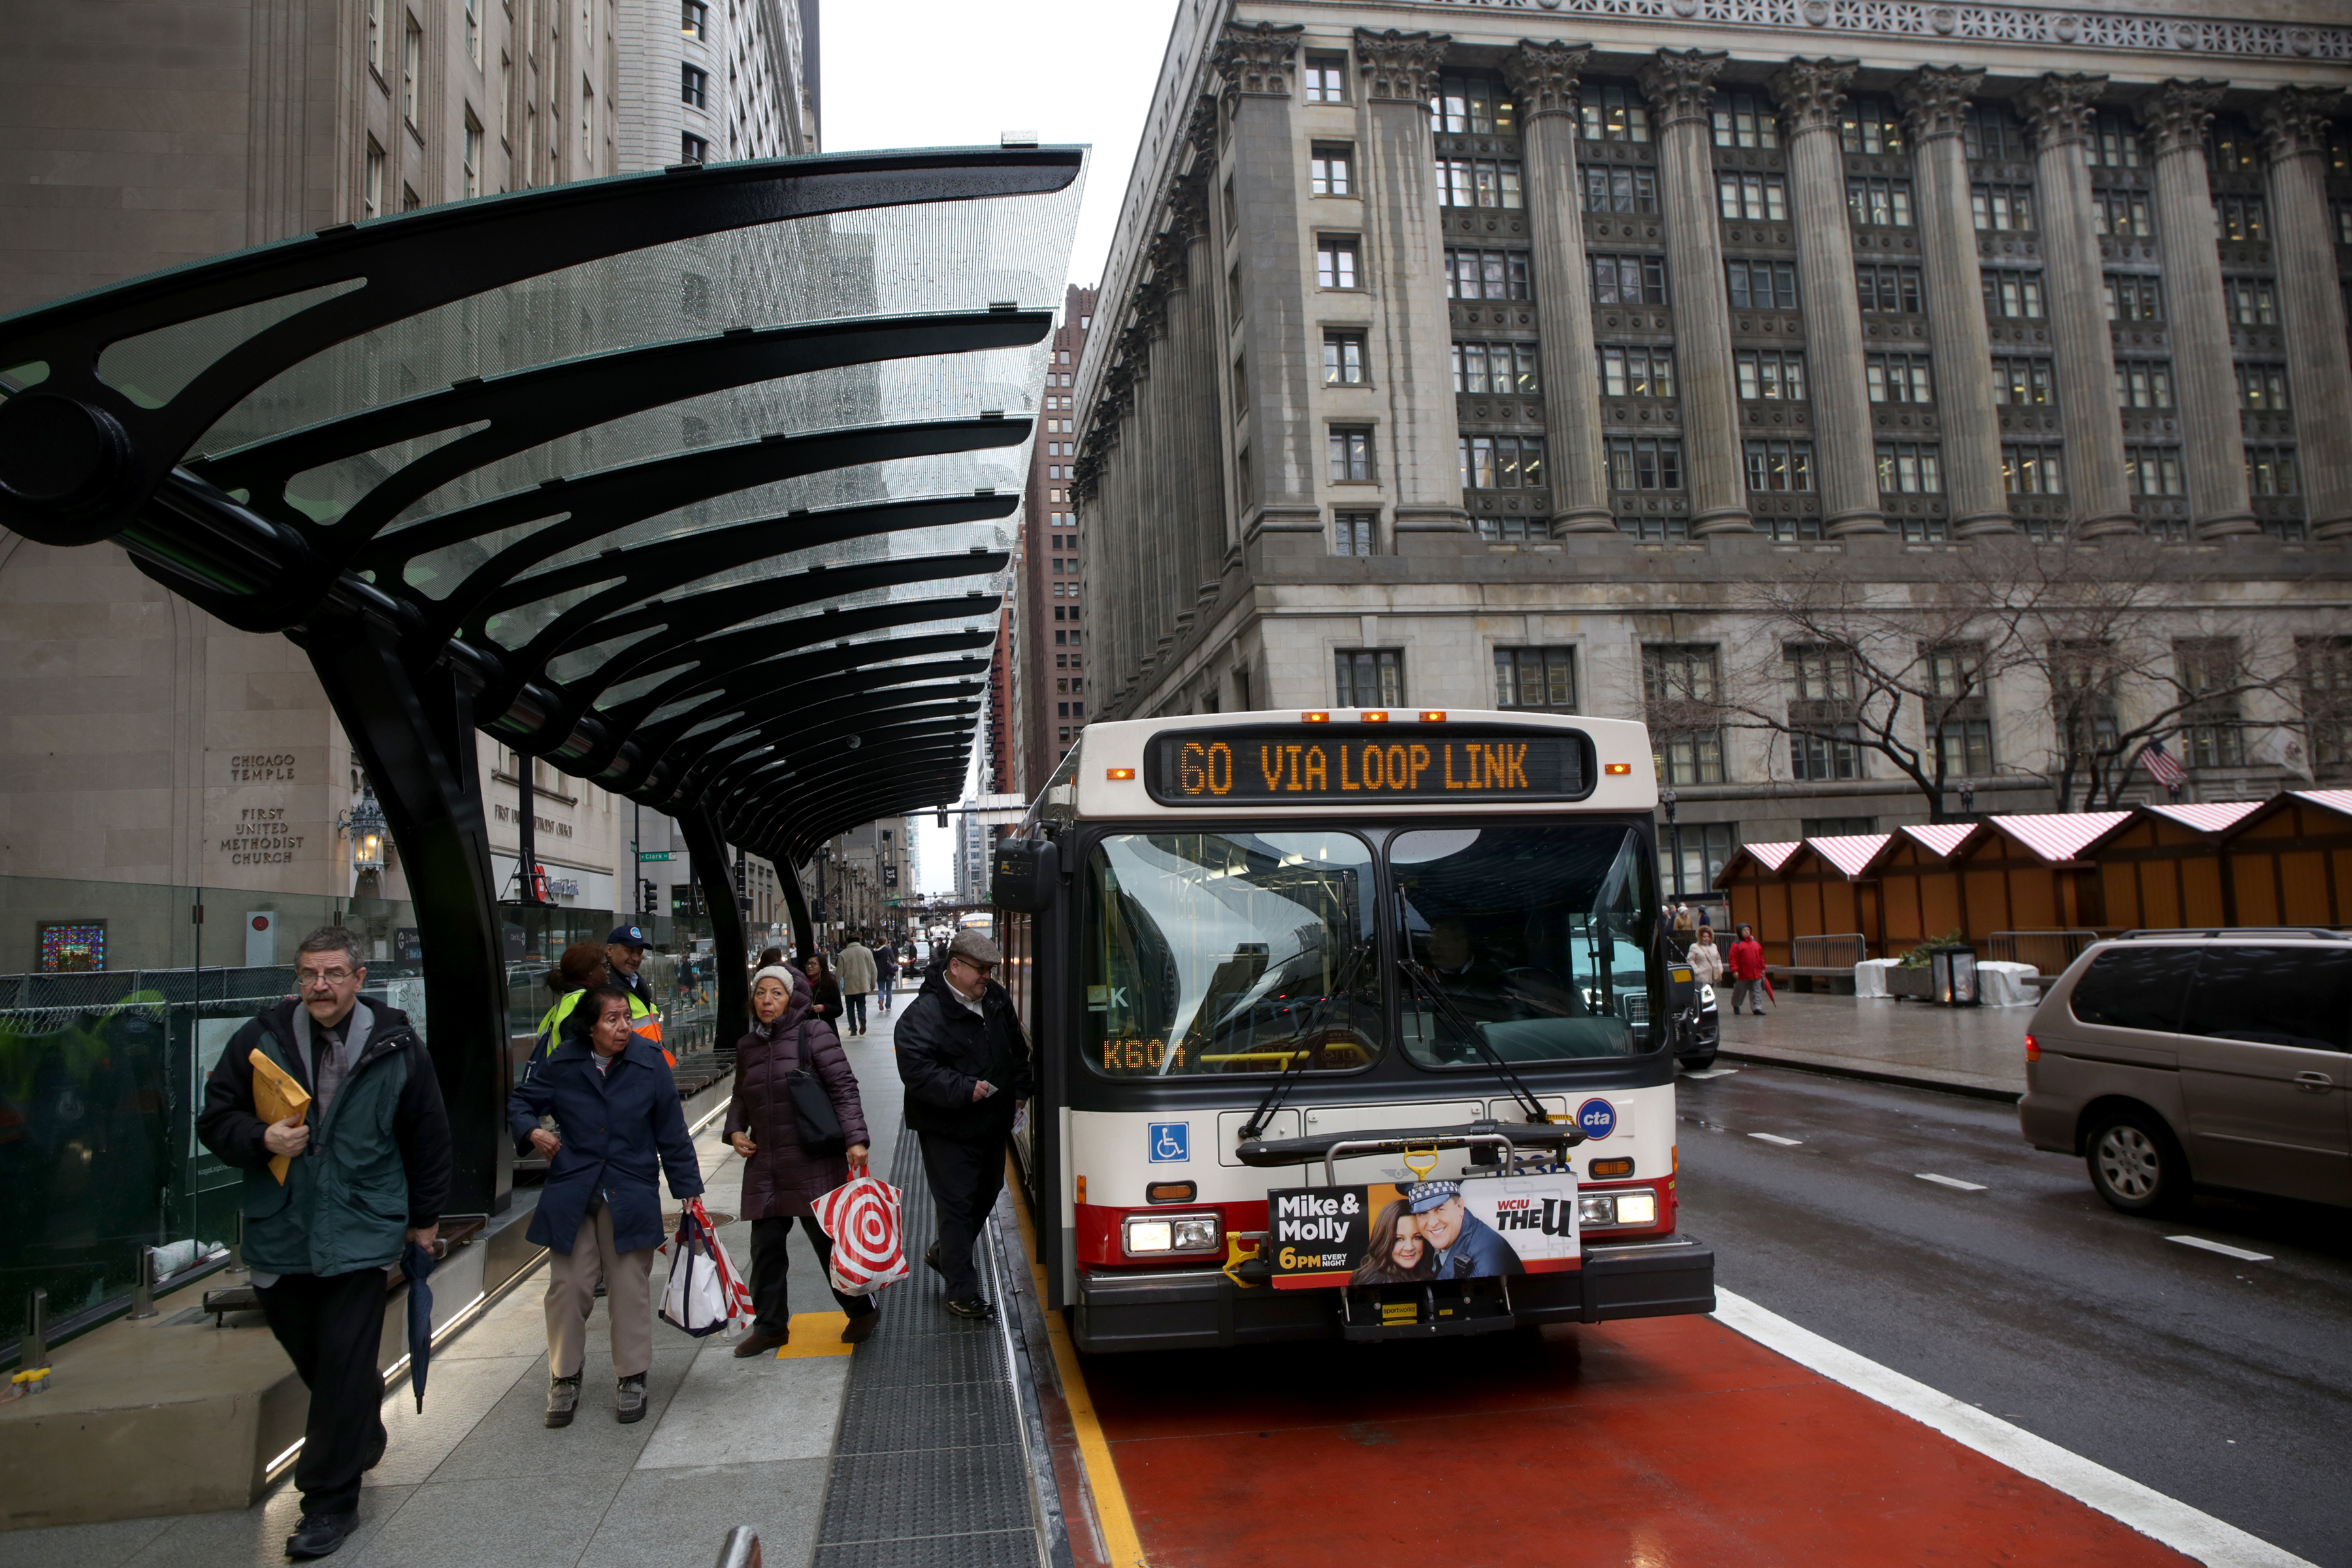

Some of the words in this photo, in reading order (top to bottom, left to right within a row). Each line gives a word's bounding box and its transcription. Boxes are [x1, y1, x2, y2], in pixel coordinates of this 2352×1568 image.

[231, 754, 295, 766] CHICAGO
[231, 768, 294, 781] TEMPLE
[1181, 743, 1231, 794] 60
[1262, 745, 1326, 790] VIA
[1341, 745, 1430, 789] LOOP
[1445, 744, 1528, 789] LINK
[242, 808, 284, 820] FIRST
[495, 804, 510, 821] FIRST
[236, 823, 288, 834] UNITED
[221, 836, 304, 850] METHODIST
[232, 852, 292, 864] CHURCH
[1111, 987, 1129, 1007] K
[1584, 1111, 1610, 1125] cta
[1279, 1194, 1339, 1218] Mike
[1341, 1193, 1360, 1215] &
[1497, 1199, 1529, 1210] WCIU
[1496, 1209, 1543, 1231] THE
[1541, 1198, 1571, 1237] U
[1279, 1217, 1350, 1243] Molly
